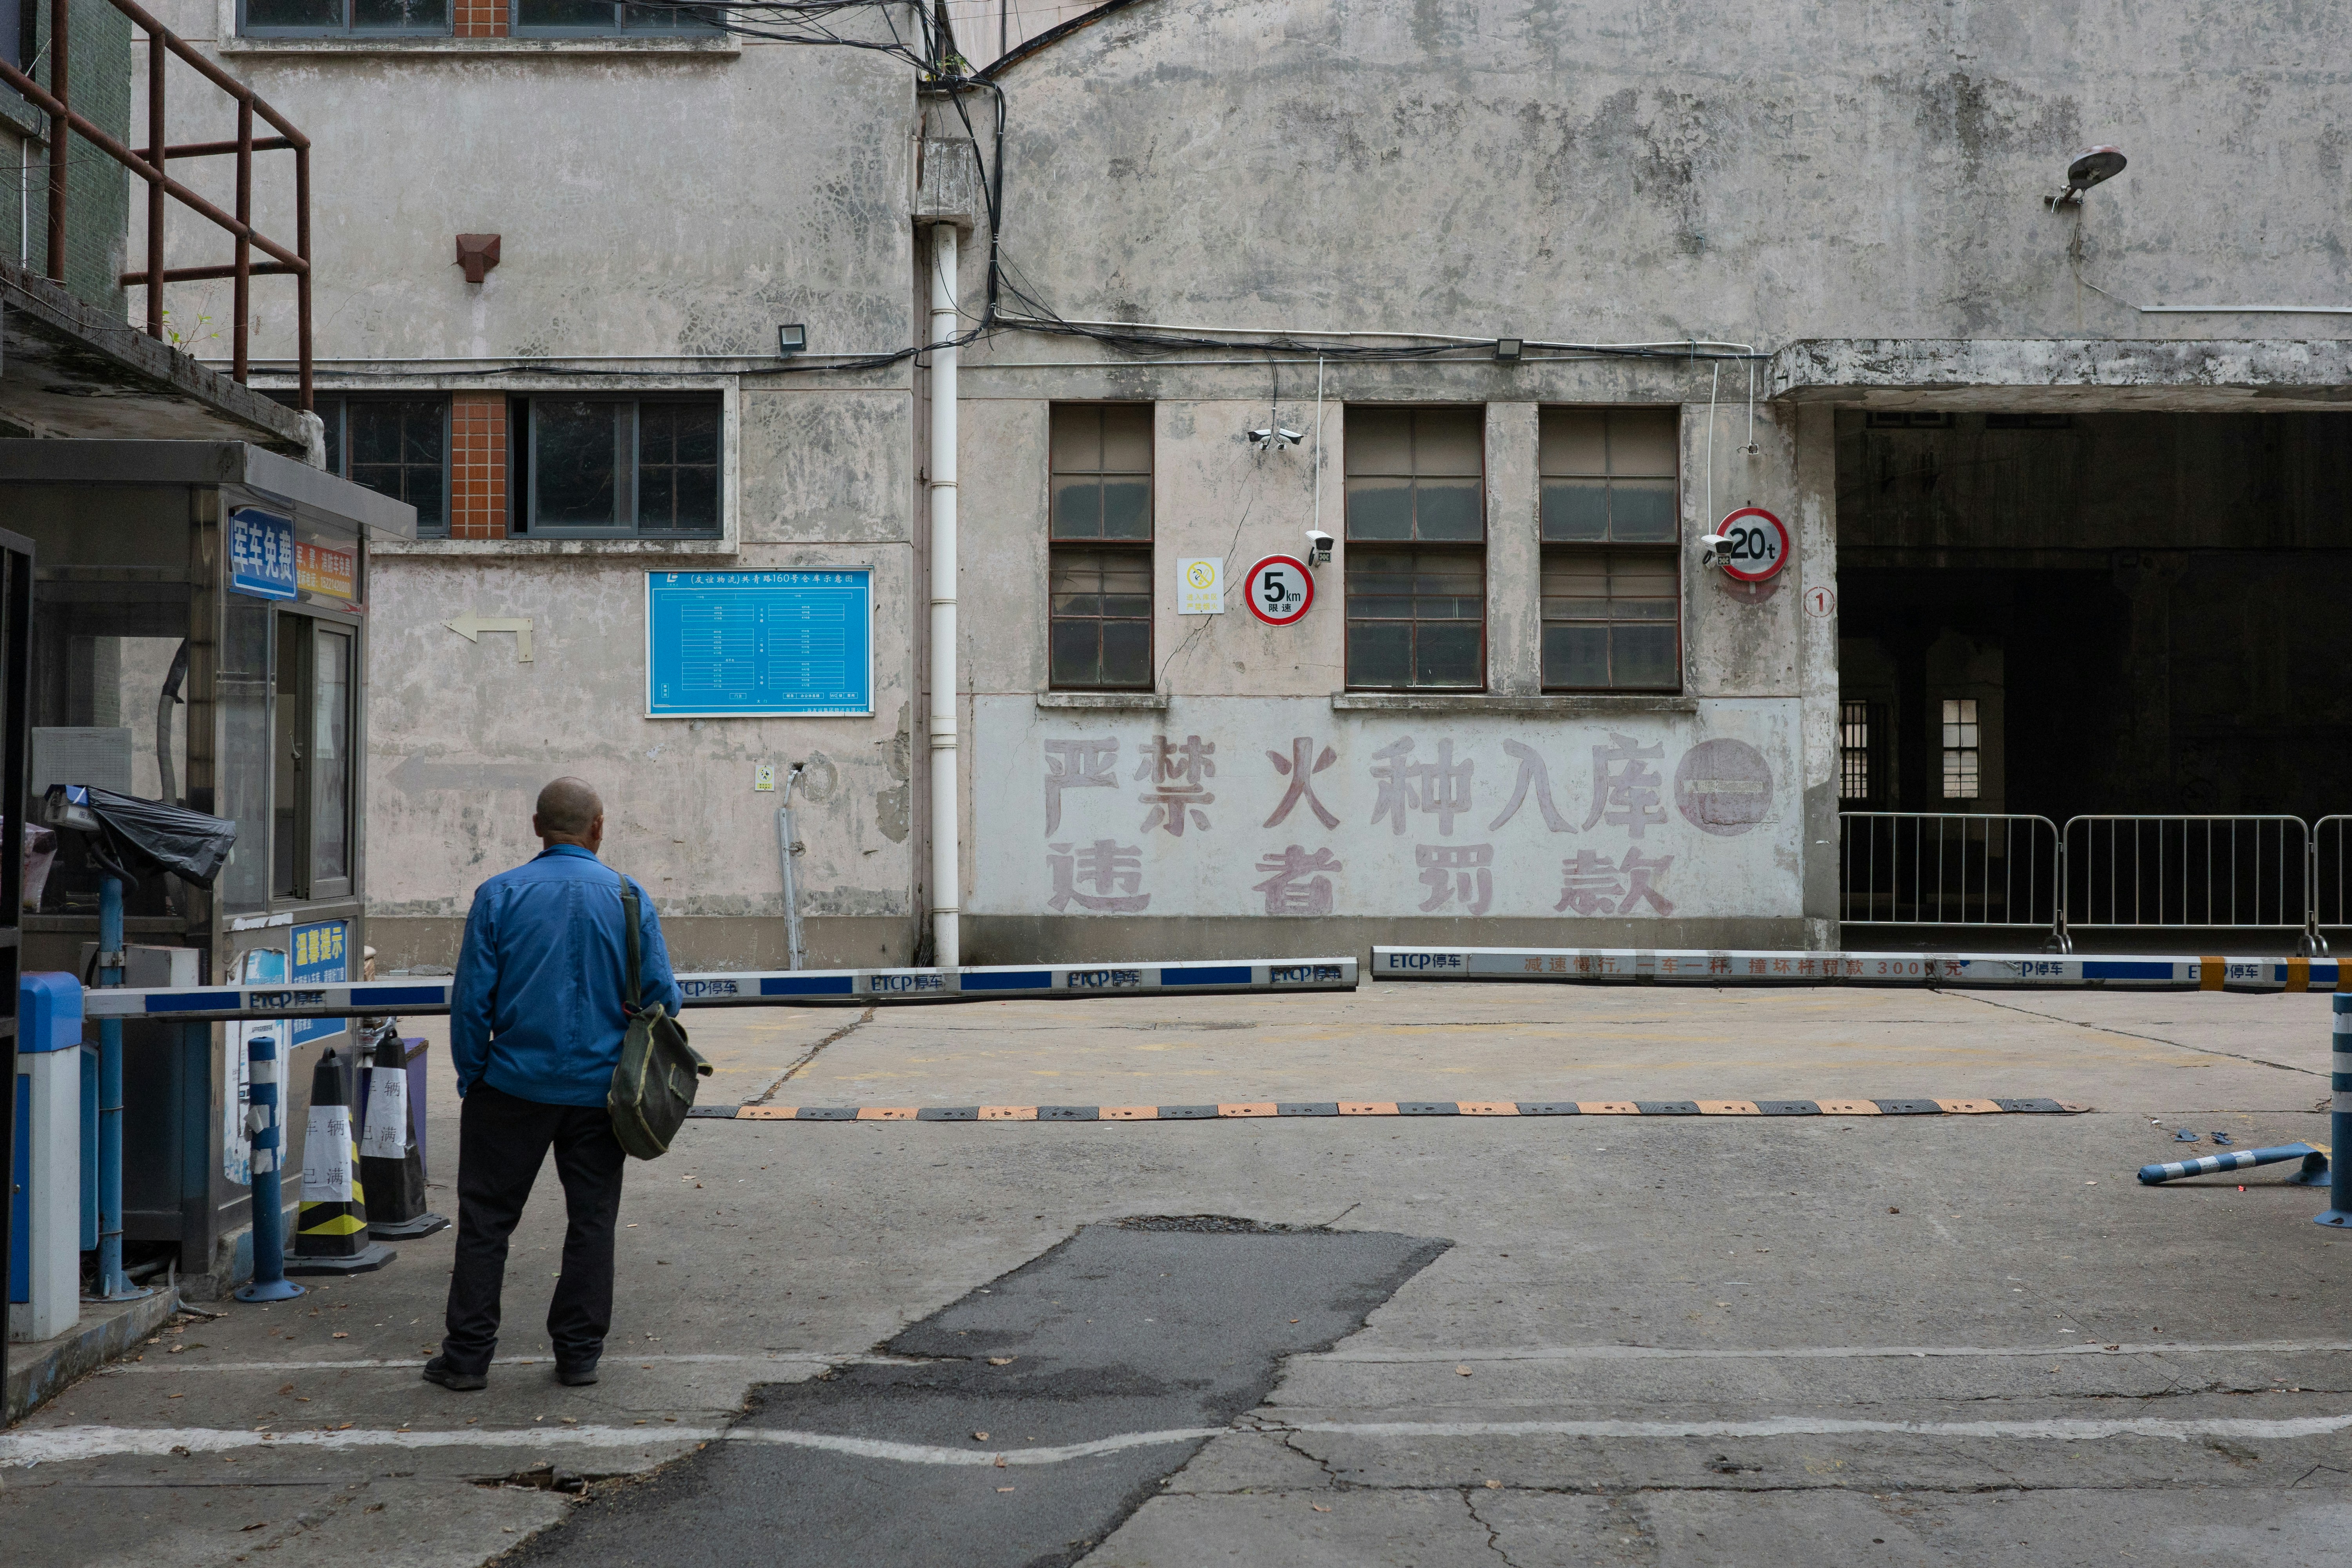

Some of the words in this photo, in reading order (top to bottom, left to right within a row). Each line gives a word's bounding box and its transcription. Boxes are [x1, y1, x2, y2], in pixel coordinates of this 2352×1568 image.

[234, 520, 292, 582] 军车免费
[1730, 528, 1775, 559] 20t
[1269, 604, 1292, 612] 限速
[1815, 593, 1823, 612] 1
[1044, 732, 1668, 839] 严禁火种入库
[1046, 839, 1675, 917] 违者罚款
[296, 926, 343, 966] 温馨提示
[303, 1168, 343, 1185] 已满
